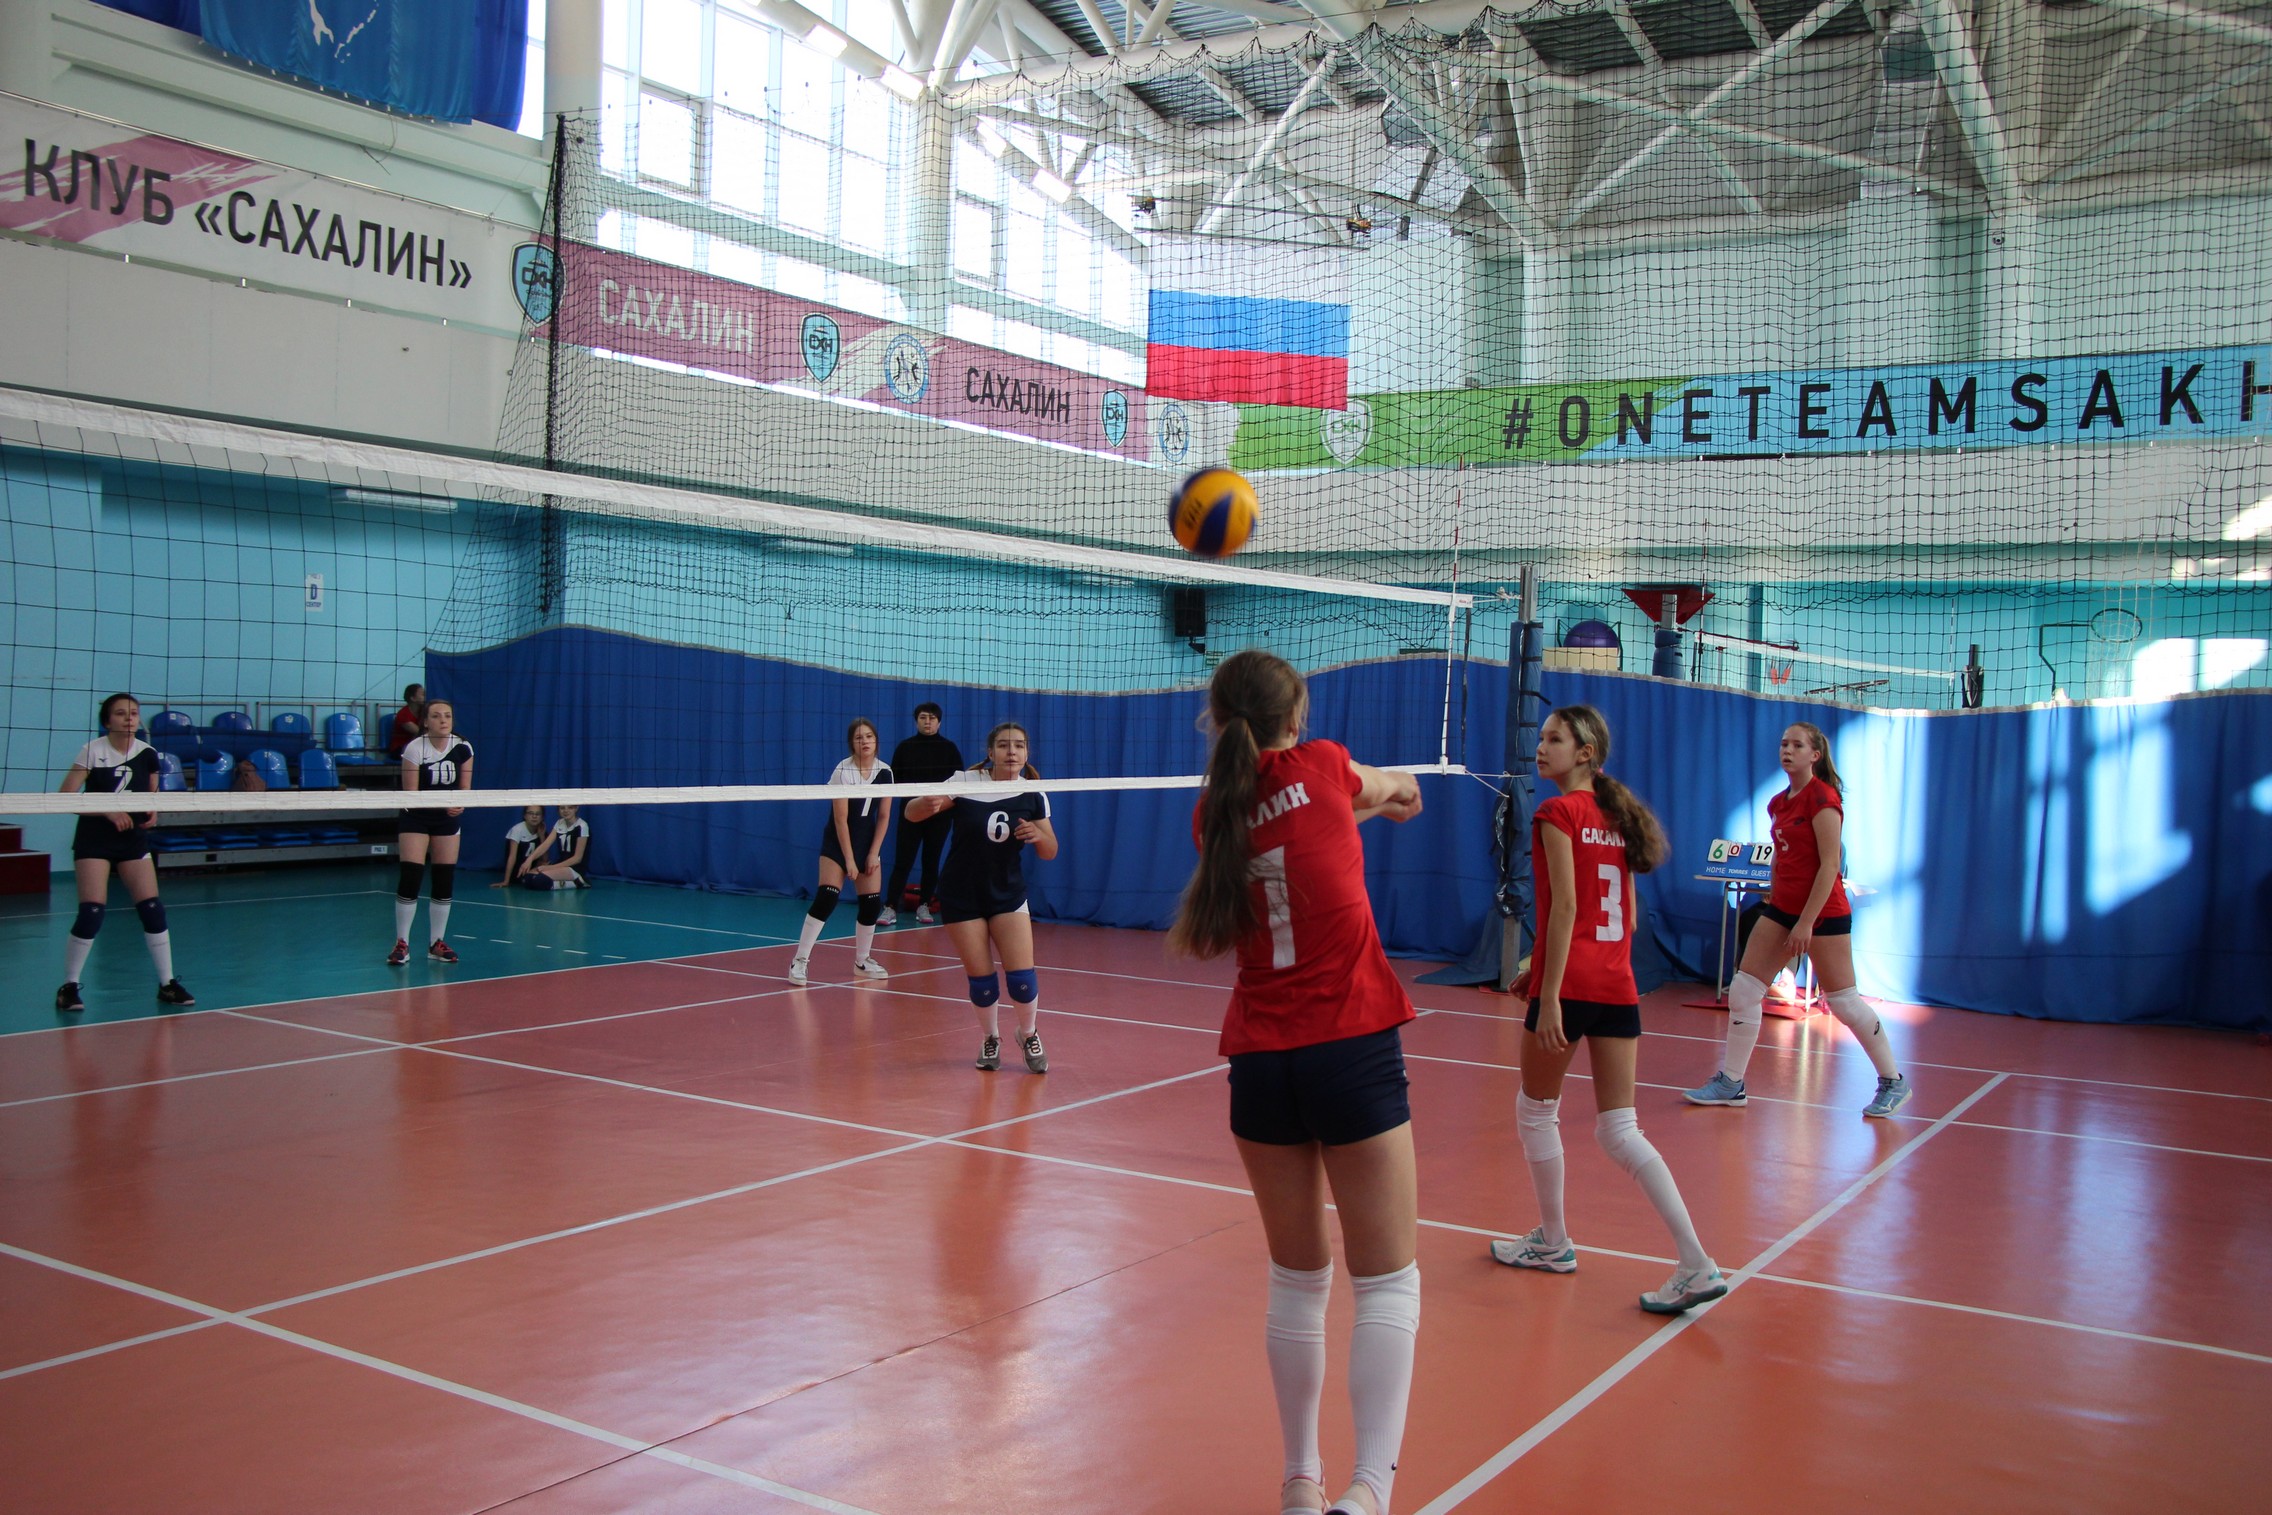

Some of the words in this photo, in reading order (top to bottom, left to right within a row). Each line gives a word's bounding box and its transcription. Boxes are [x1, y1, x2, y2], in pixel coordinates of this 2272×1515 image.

[25, 138, 174, 225] КЛУБ
[195, 191, 472, 289] «САХАЛИН»
[600, 279, 753, 353] САХАЛИН
[967, 368, 1070, 424] САХАЛИН
[114, 766, 133, 793] 2
[428, 760, 456, 785] 10
[1247, 782, 1310, 830] ЛИН
[987, 811, 1010, 842] 6
[1775, 829, 1789, 851] 5
[1706, 866, 1726, 874] HOME
[1751, 869, 1771, 877] GUEST
[1713, 844, 1723, 859] 6
[1730, 845, 1740, 855] 0
[1756, 845, 1773, 860] 19
[1247, 845, 1296, 969] 1
[1596, 863, 1624, 941] 3
